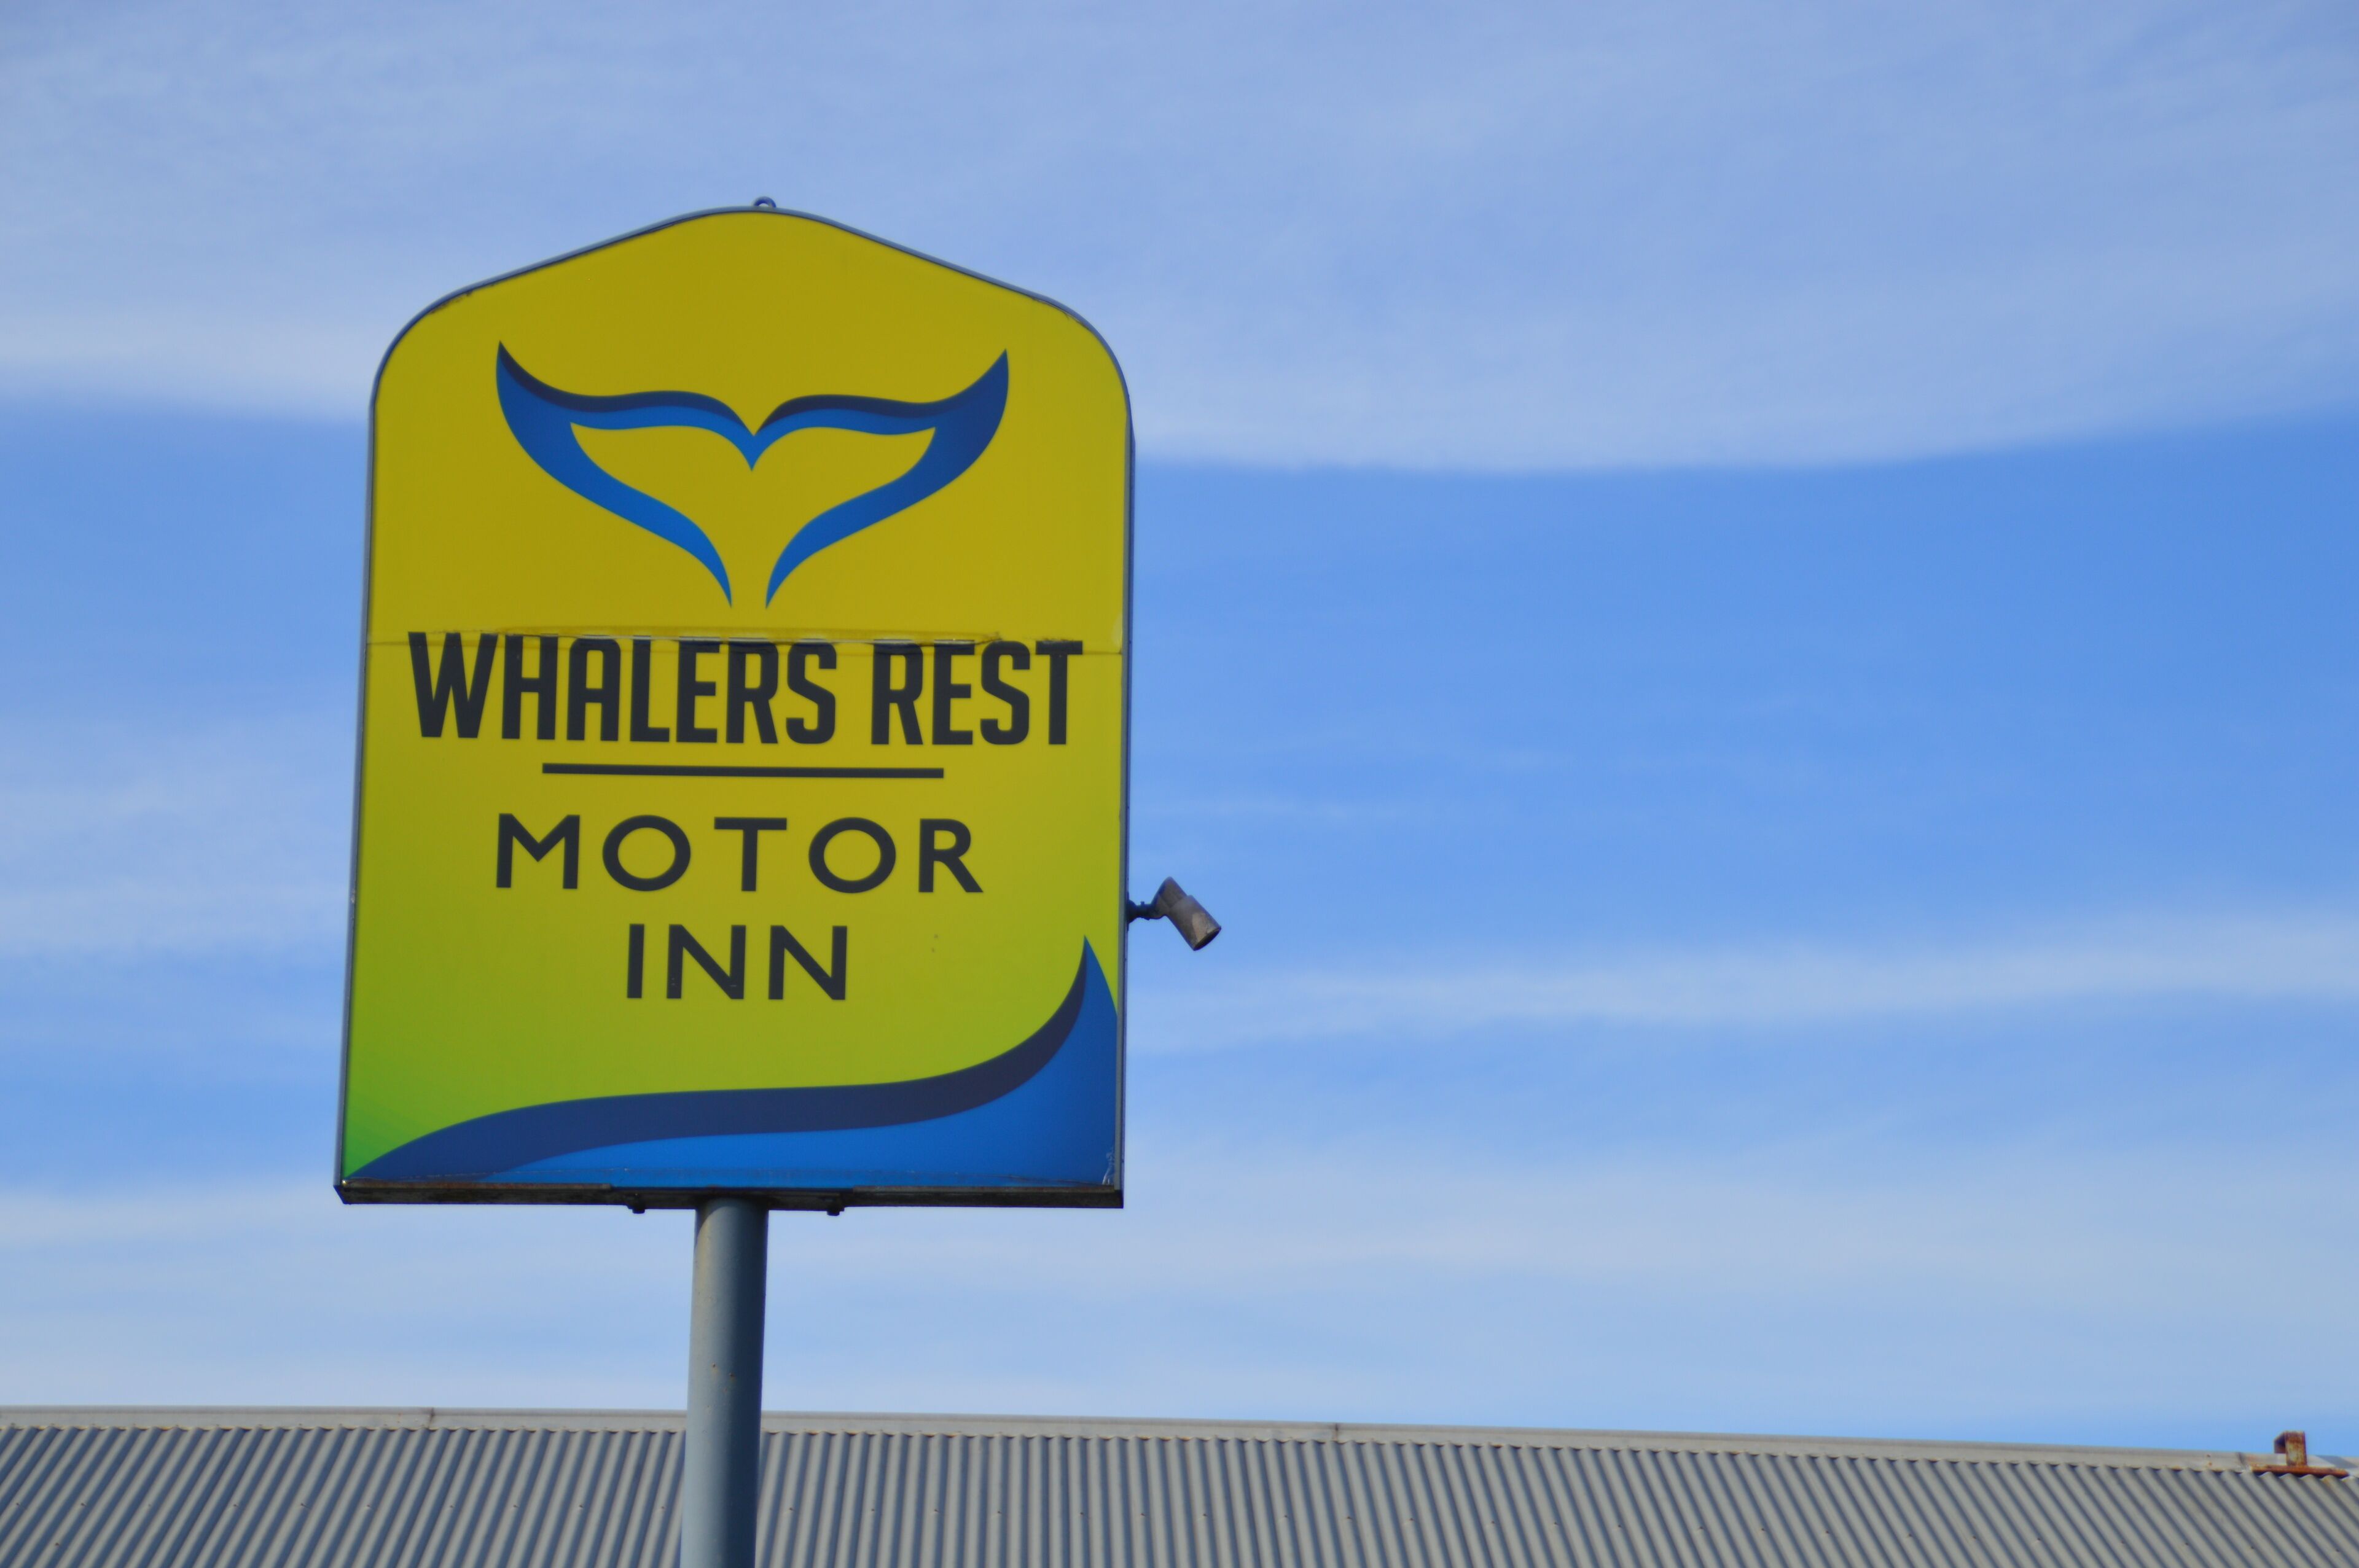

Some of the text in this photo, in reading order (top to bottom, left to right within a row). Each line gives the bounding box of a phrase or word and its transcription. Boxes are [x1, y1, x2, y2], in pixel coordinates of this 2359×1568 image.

[408, 632, 1084, 746] WHALERS REST
[496, 813, 984, 894] MOTOR
[626, 924, 848, 1000] INN
